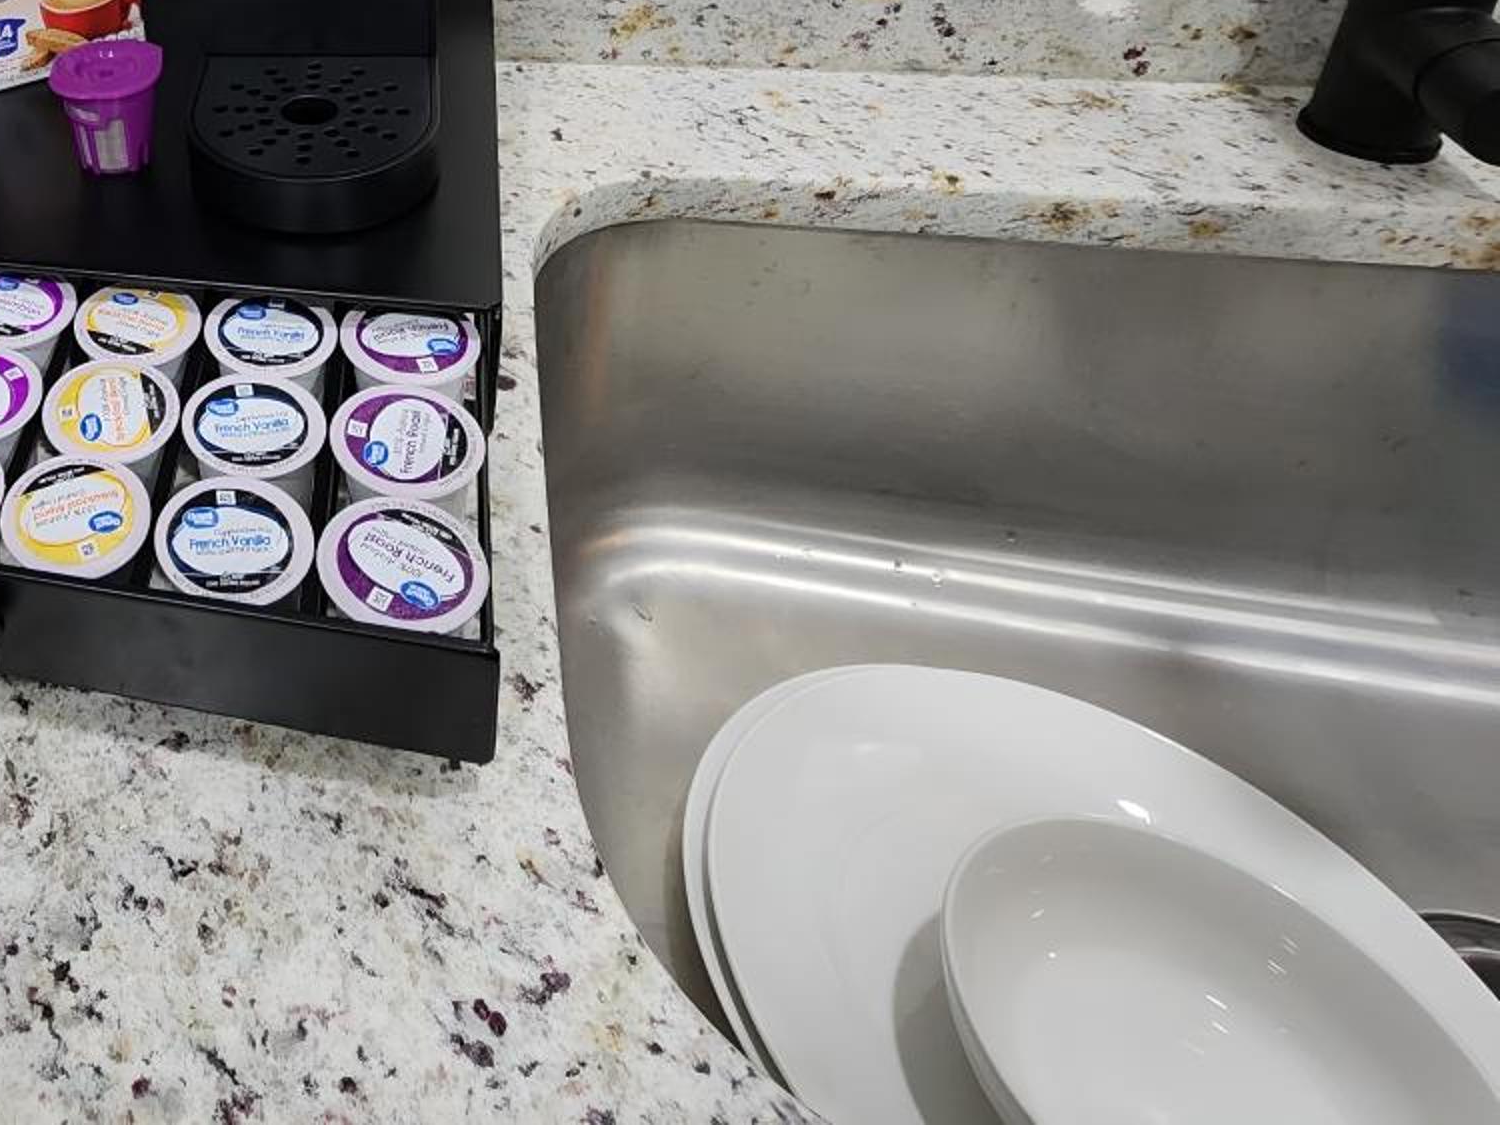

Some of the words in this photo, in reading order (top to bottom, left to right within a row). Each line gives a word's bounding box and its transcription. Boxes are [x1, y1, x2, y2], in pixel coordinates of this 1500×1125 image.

[189, 537, 229, 550] French
[231, 535, 271, 546] Vanilla
[362, 531, 401, 558] Roast
[404, 553, 455, 584] French
